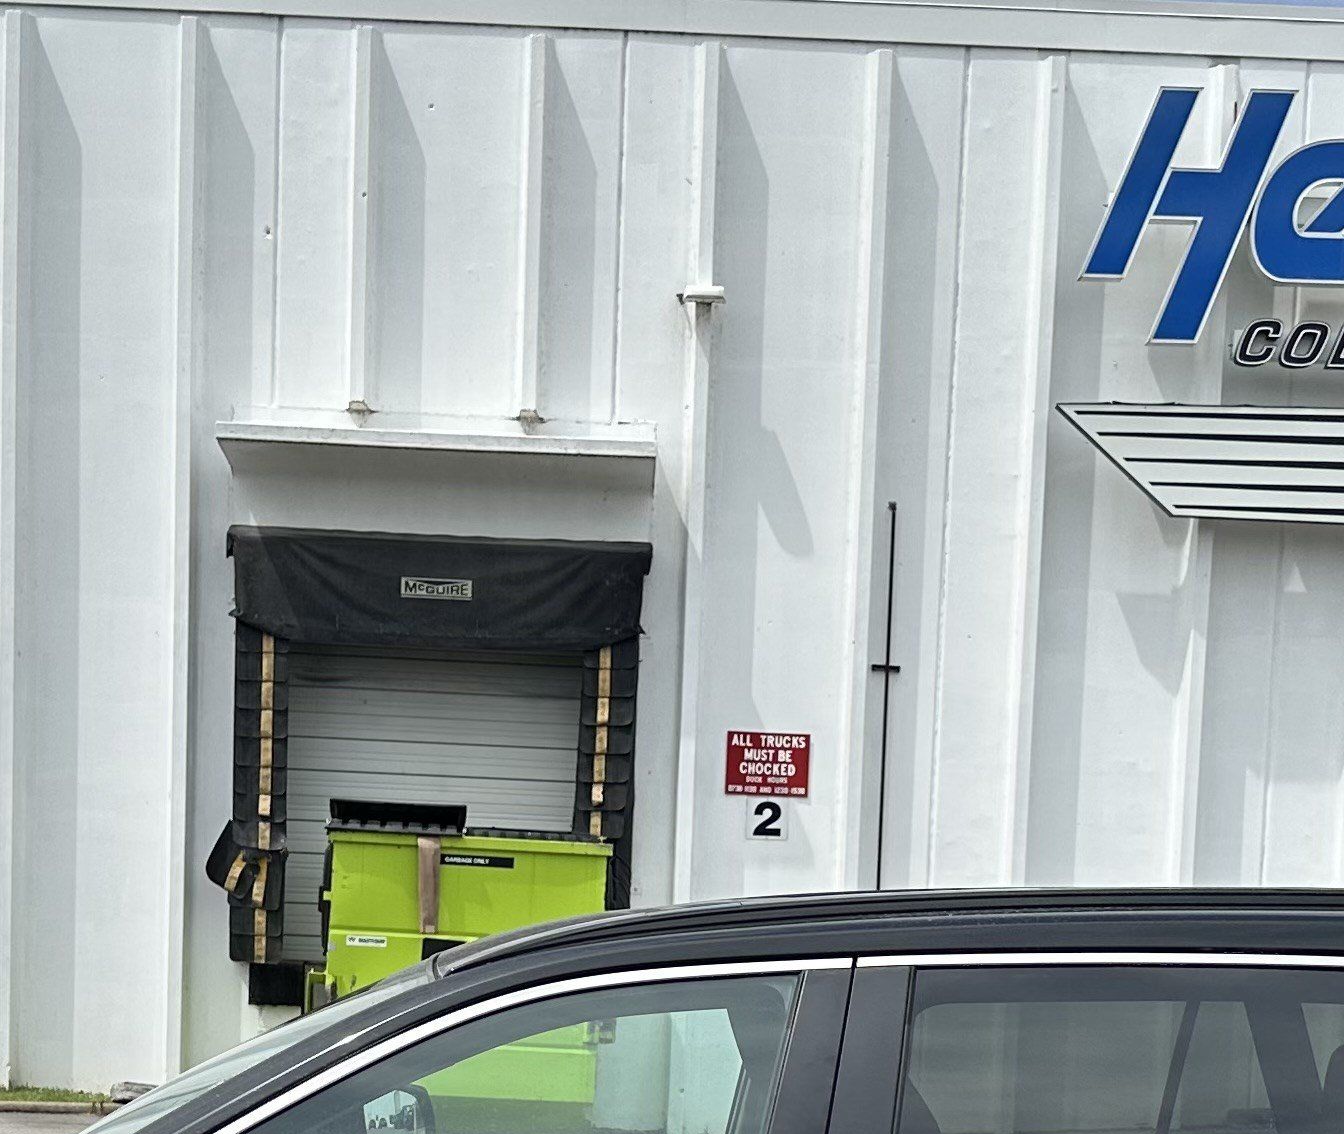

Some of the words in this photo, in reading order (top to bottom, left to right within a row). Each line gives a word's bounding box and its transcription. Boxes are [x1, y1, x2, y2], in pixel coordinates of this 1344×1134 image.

[732, 734, 753, 746] ALL
[760, 735, 806, 748] TRUCKS
[744, 748, 775, 762] MUST
[778, 750, 793, 762] BE
[739, 762, 796, 776] CHOCKED
[753, 801, 781, 837] 2
